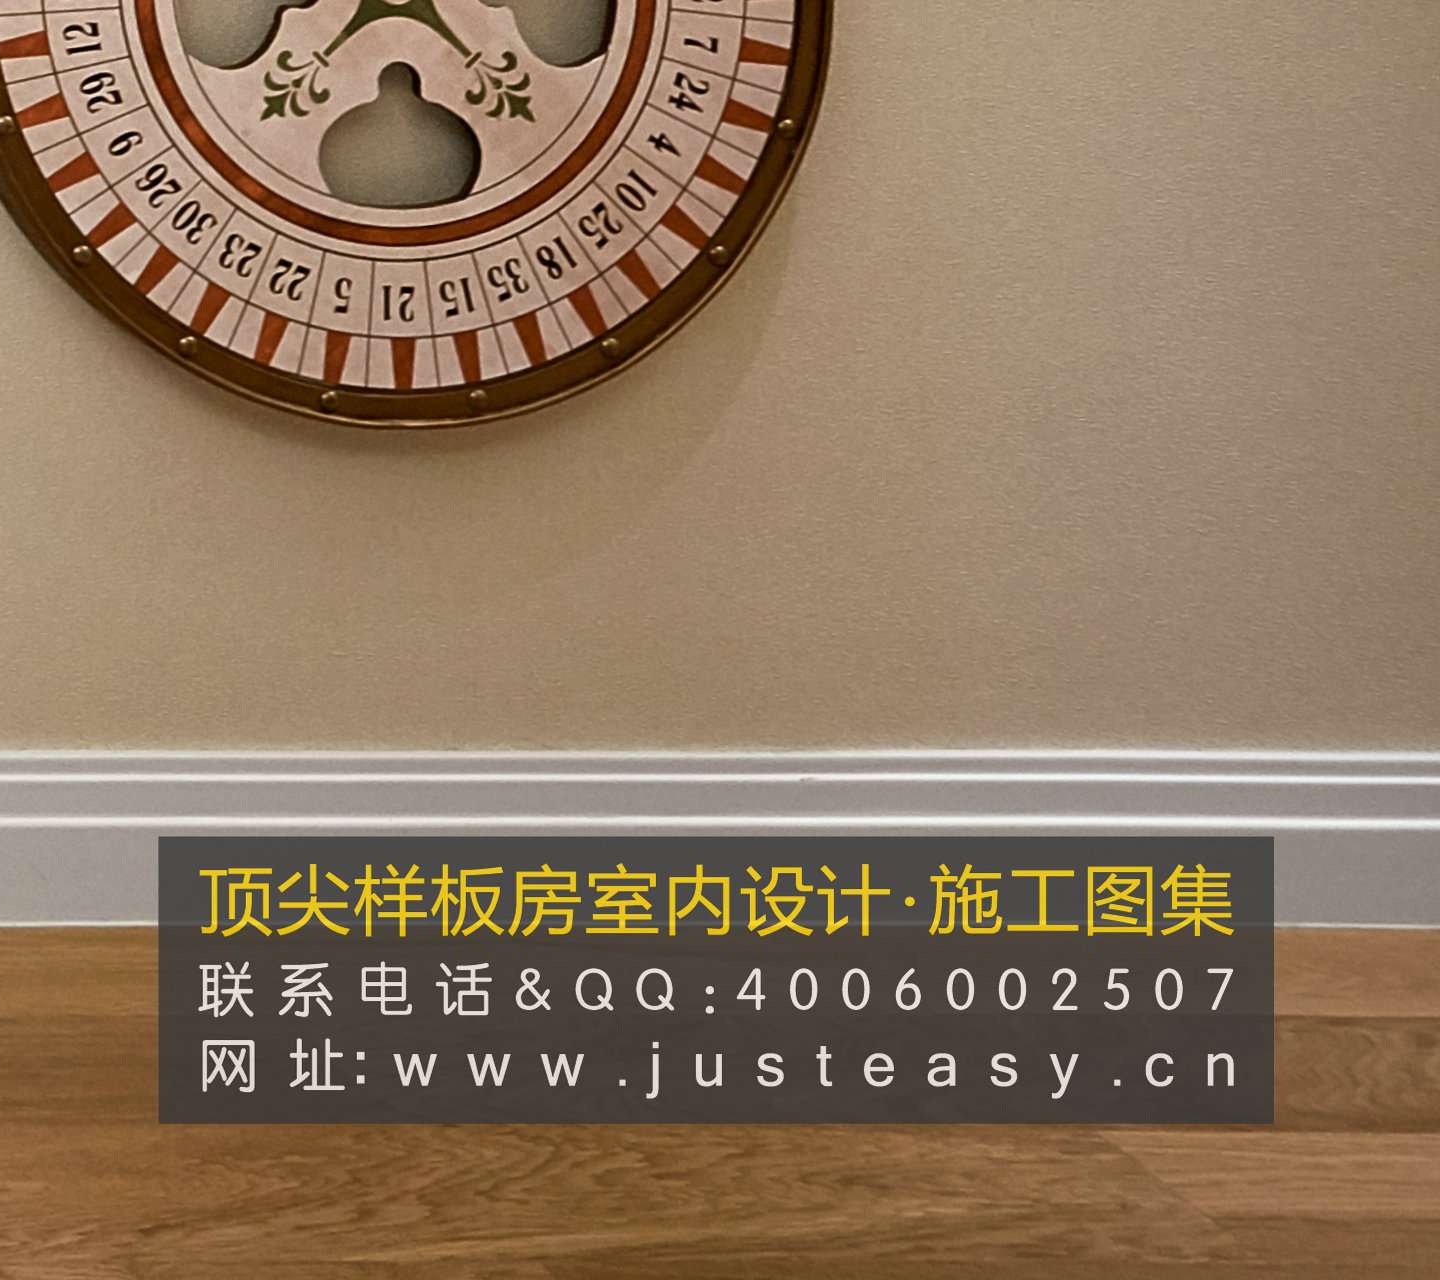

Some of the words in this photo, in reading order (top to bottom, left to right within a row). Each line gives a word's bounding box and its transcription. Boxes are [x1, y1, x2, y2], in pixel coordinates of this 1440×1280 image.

[63, 23, 101, 55] 12
[684, 38, 718, 53] 7
[80, 73, 123, 113] 29
[668, 72, 709, 112] 24
[109, 132, 142, 156] 9
[648, 134, 680, 156] 4
[136, 164, 182, 208] 26
[616, 170, 657, 211] 10
[172, 201, 217, 244] 30
[579, 202, 619, 249] 25
[219, 234, 262, 277] 23
[536, 237, 577, 279] 18
[270, 259, 310, 301] 22
[334, 278, 352, 313] 5
[440, 278, 474, 317] 15
[488, 259, 529, 302] 35
[383, 286, 414, 322] 21
